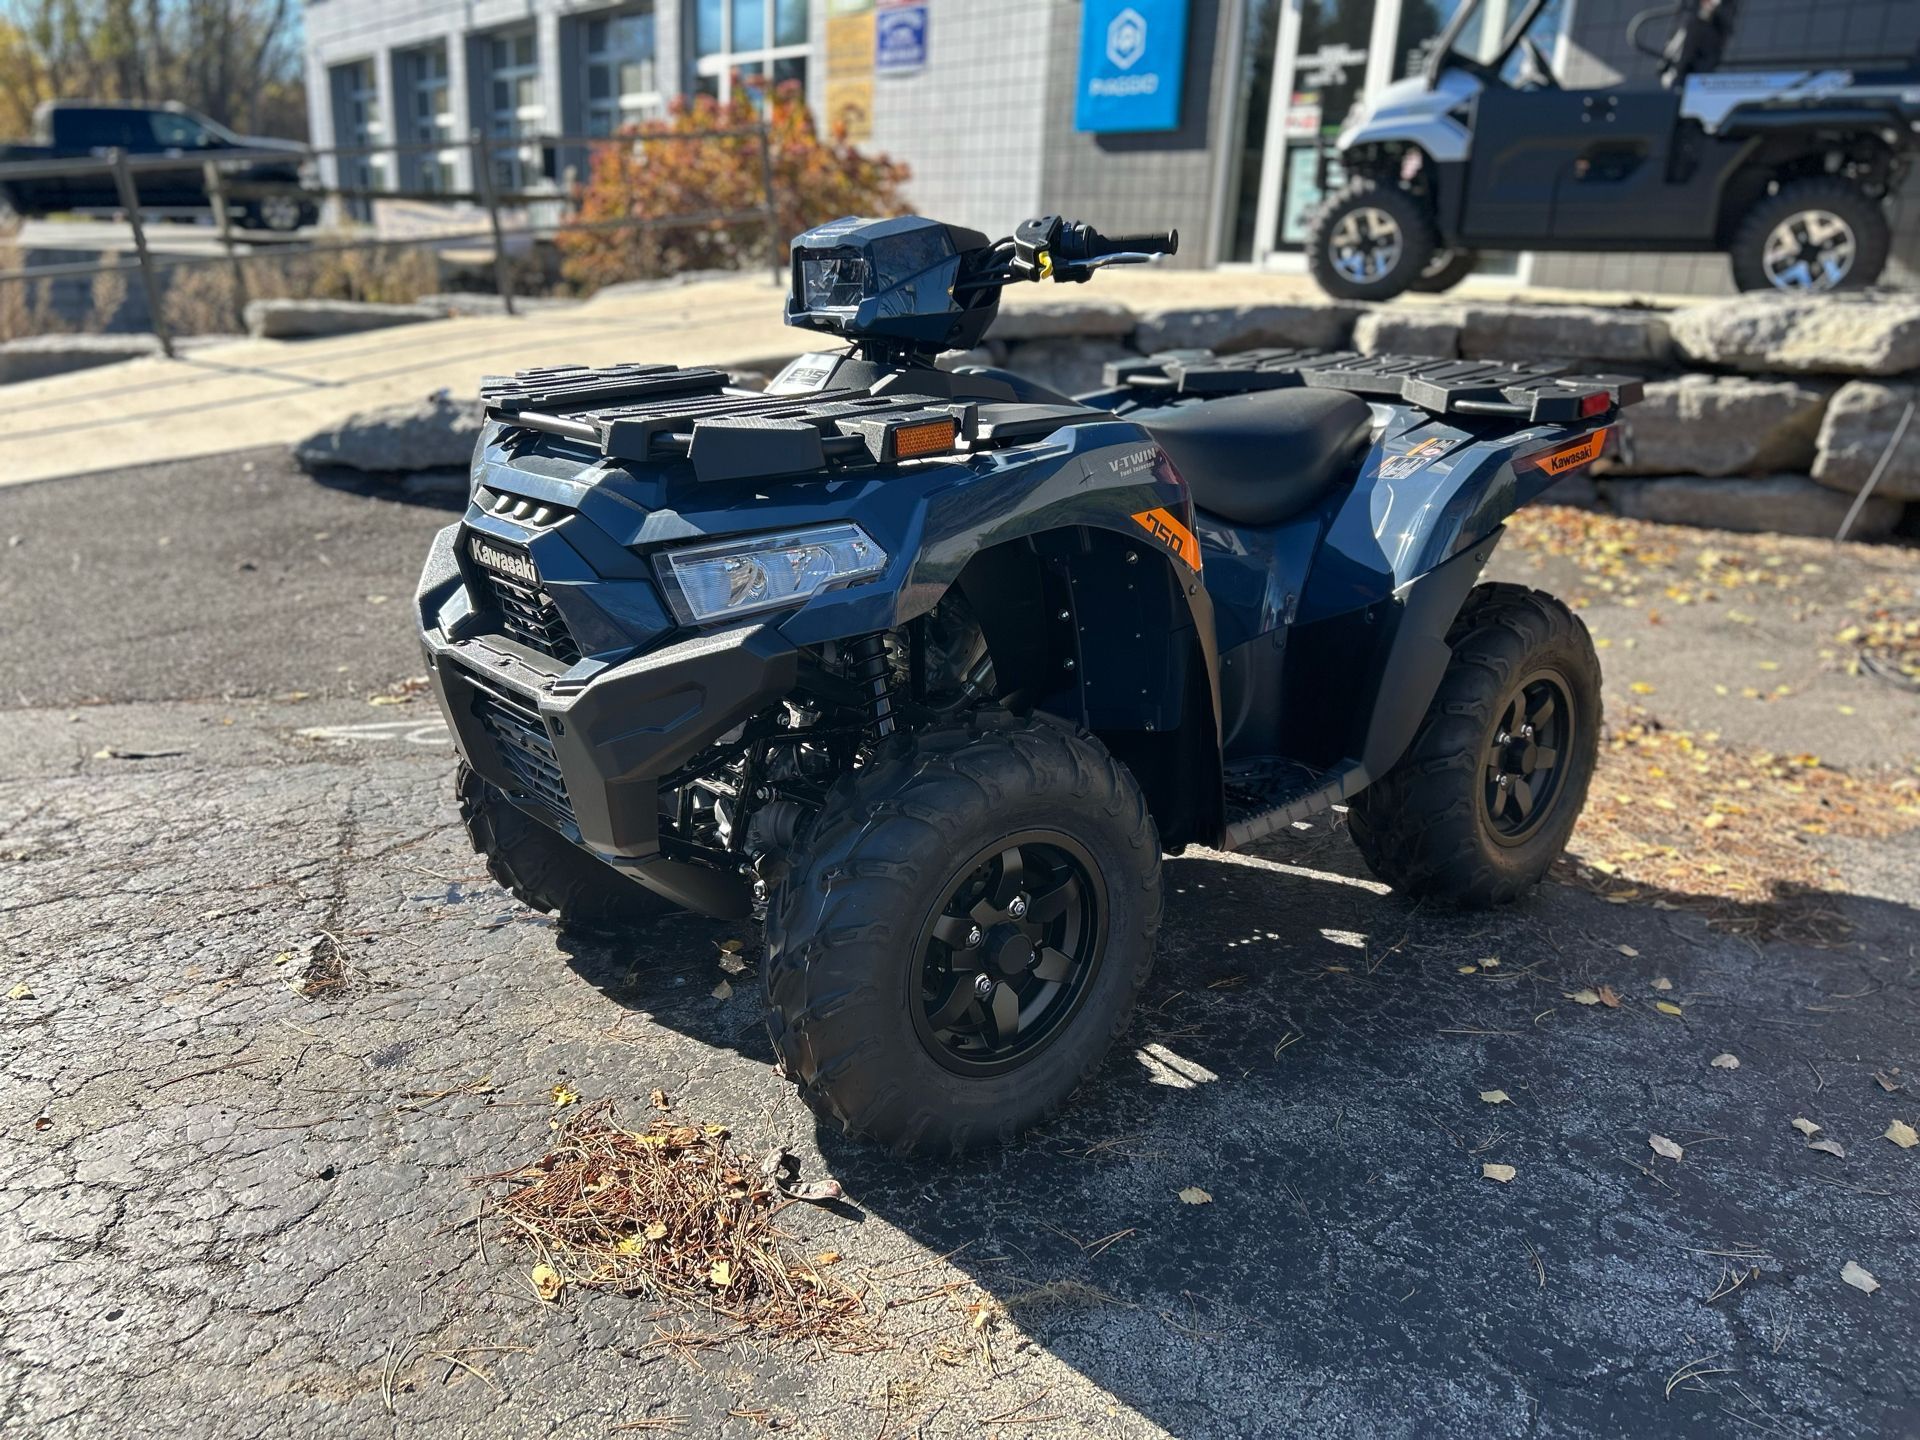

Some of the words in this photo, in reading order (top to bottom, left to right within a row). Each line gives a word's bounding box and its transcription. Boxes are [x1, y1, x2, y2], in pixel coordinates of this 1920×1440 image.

[1108, 447, 1157, 472] V-TWIN
[1551, 445, 1593, 471] Kawasaki
[1146, 513, 1184, 555] 750
[471, 537, 537, 582] Kawasaki
